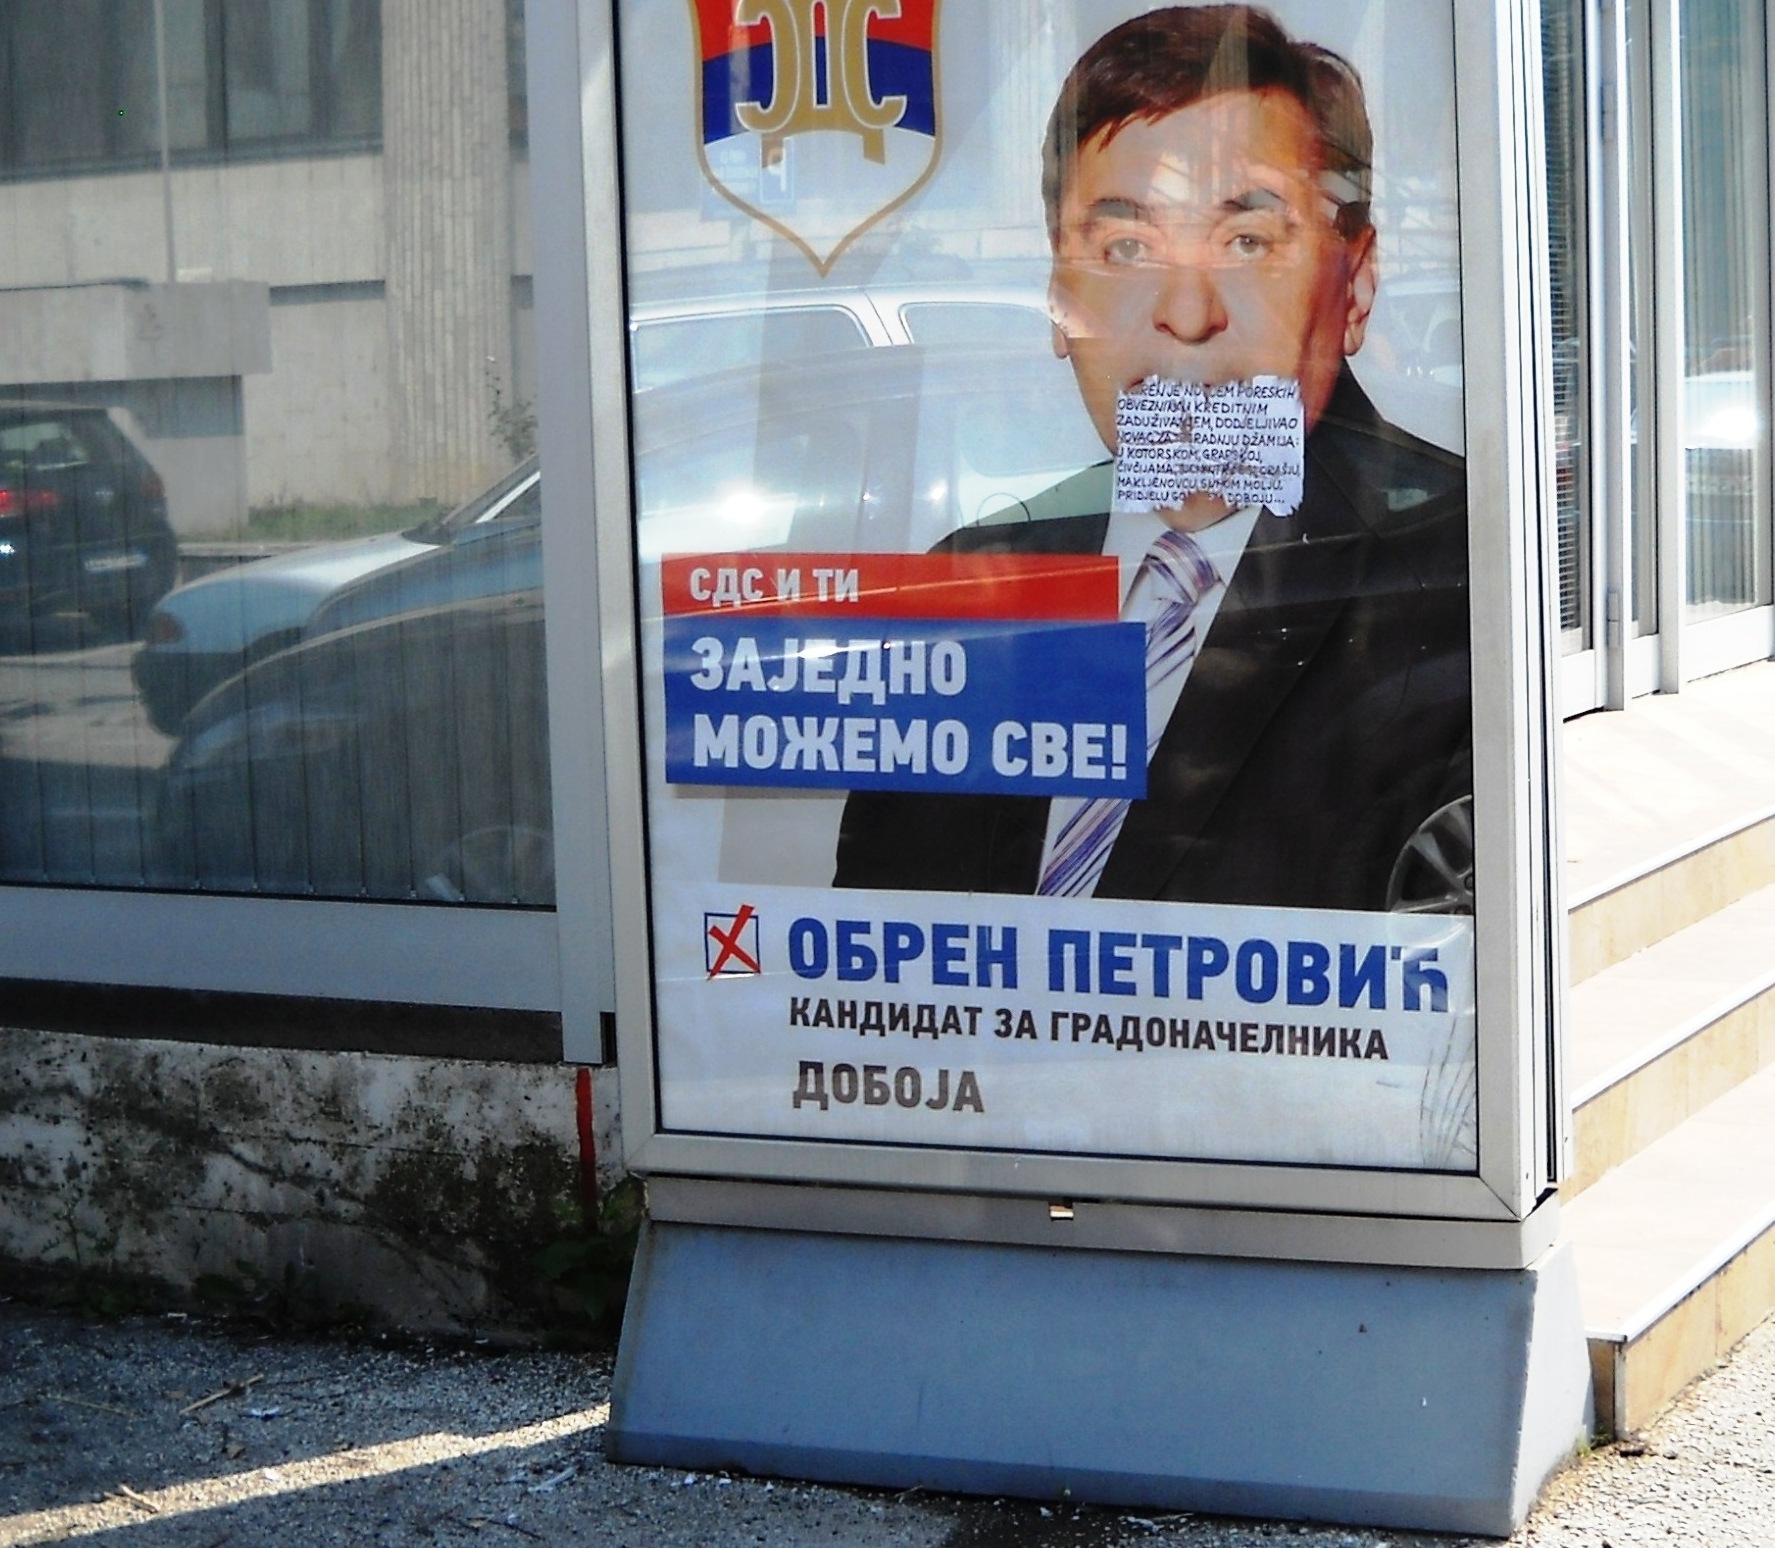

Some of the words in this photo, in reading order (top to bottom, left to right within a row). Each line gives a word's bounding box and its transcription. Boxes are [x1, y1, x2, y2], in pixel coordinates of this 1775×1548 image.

[1193, 396, 1268, 416] KREDITNIM
[1237, 383, 1295, 399] PORESKIH
[1215, 416, 1298, 431] DODJELJIVAO
[690, 568, 763, 608] СДС
[777, 570, 800, 601] И
[812, 568, 859, 603] ТИ
[690, 637, 967, 705] ЗАЈЕДНО
[693, 714, 969, 776] МОЖЕМО
[992, 721, 1128, 781] СВЕ!
[788, 917, 1018, 989] ОБРЕН
[1048, 929, 1449, 1014] ПЕТРОВИЋ
[790, 997, 982, 1040] КАНДИДАТ
[993, 1008, 1038, 1040] ЗА
[1050, 1010, 1389, 1060] ГРАДОНАЧЕЛНИКА
[792, 1060, 985, 1113] ДОБОЈА
